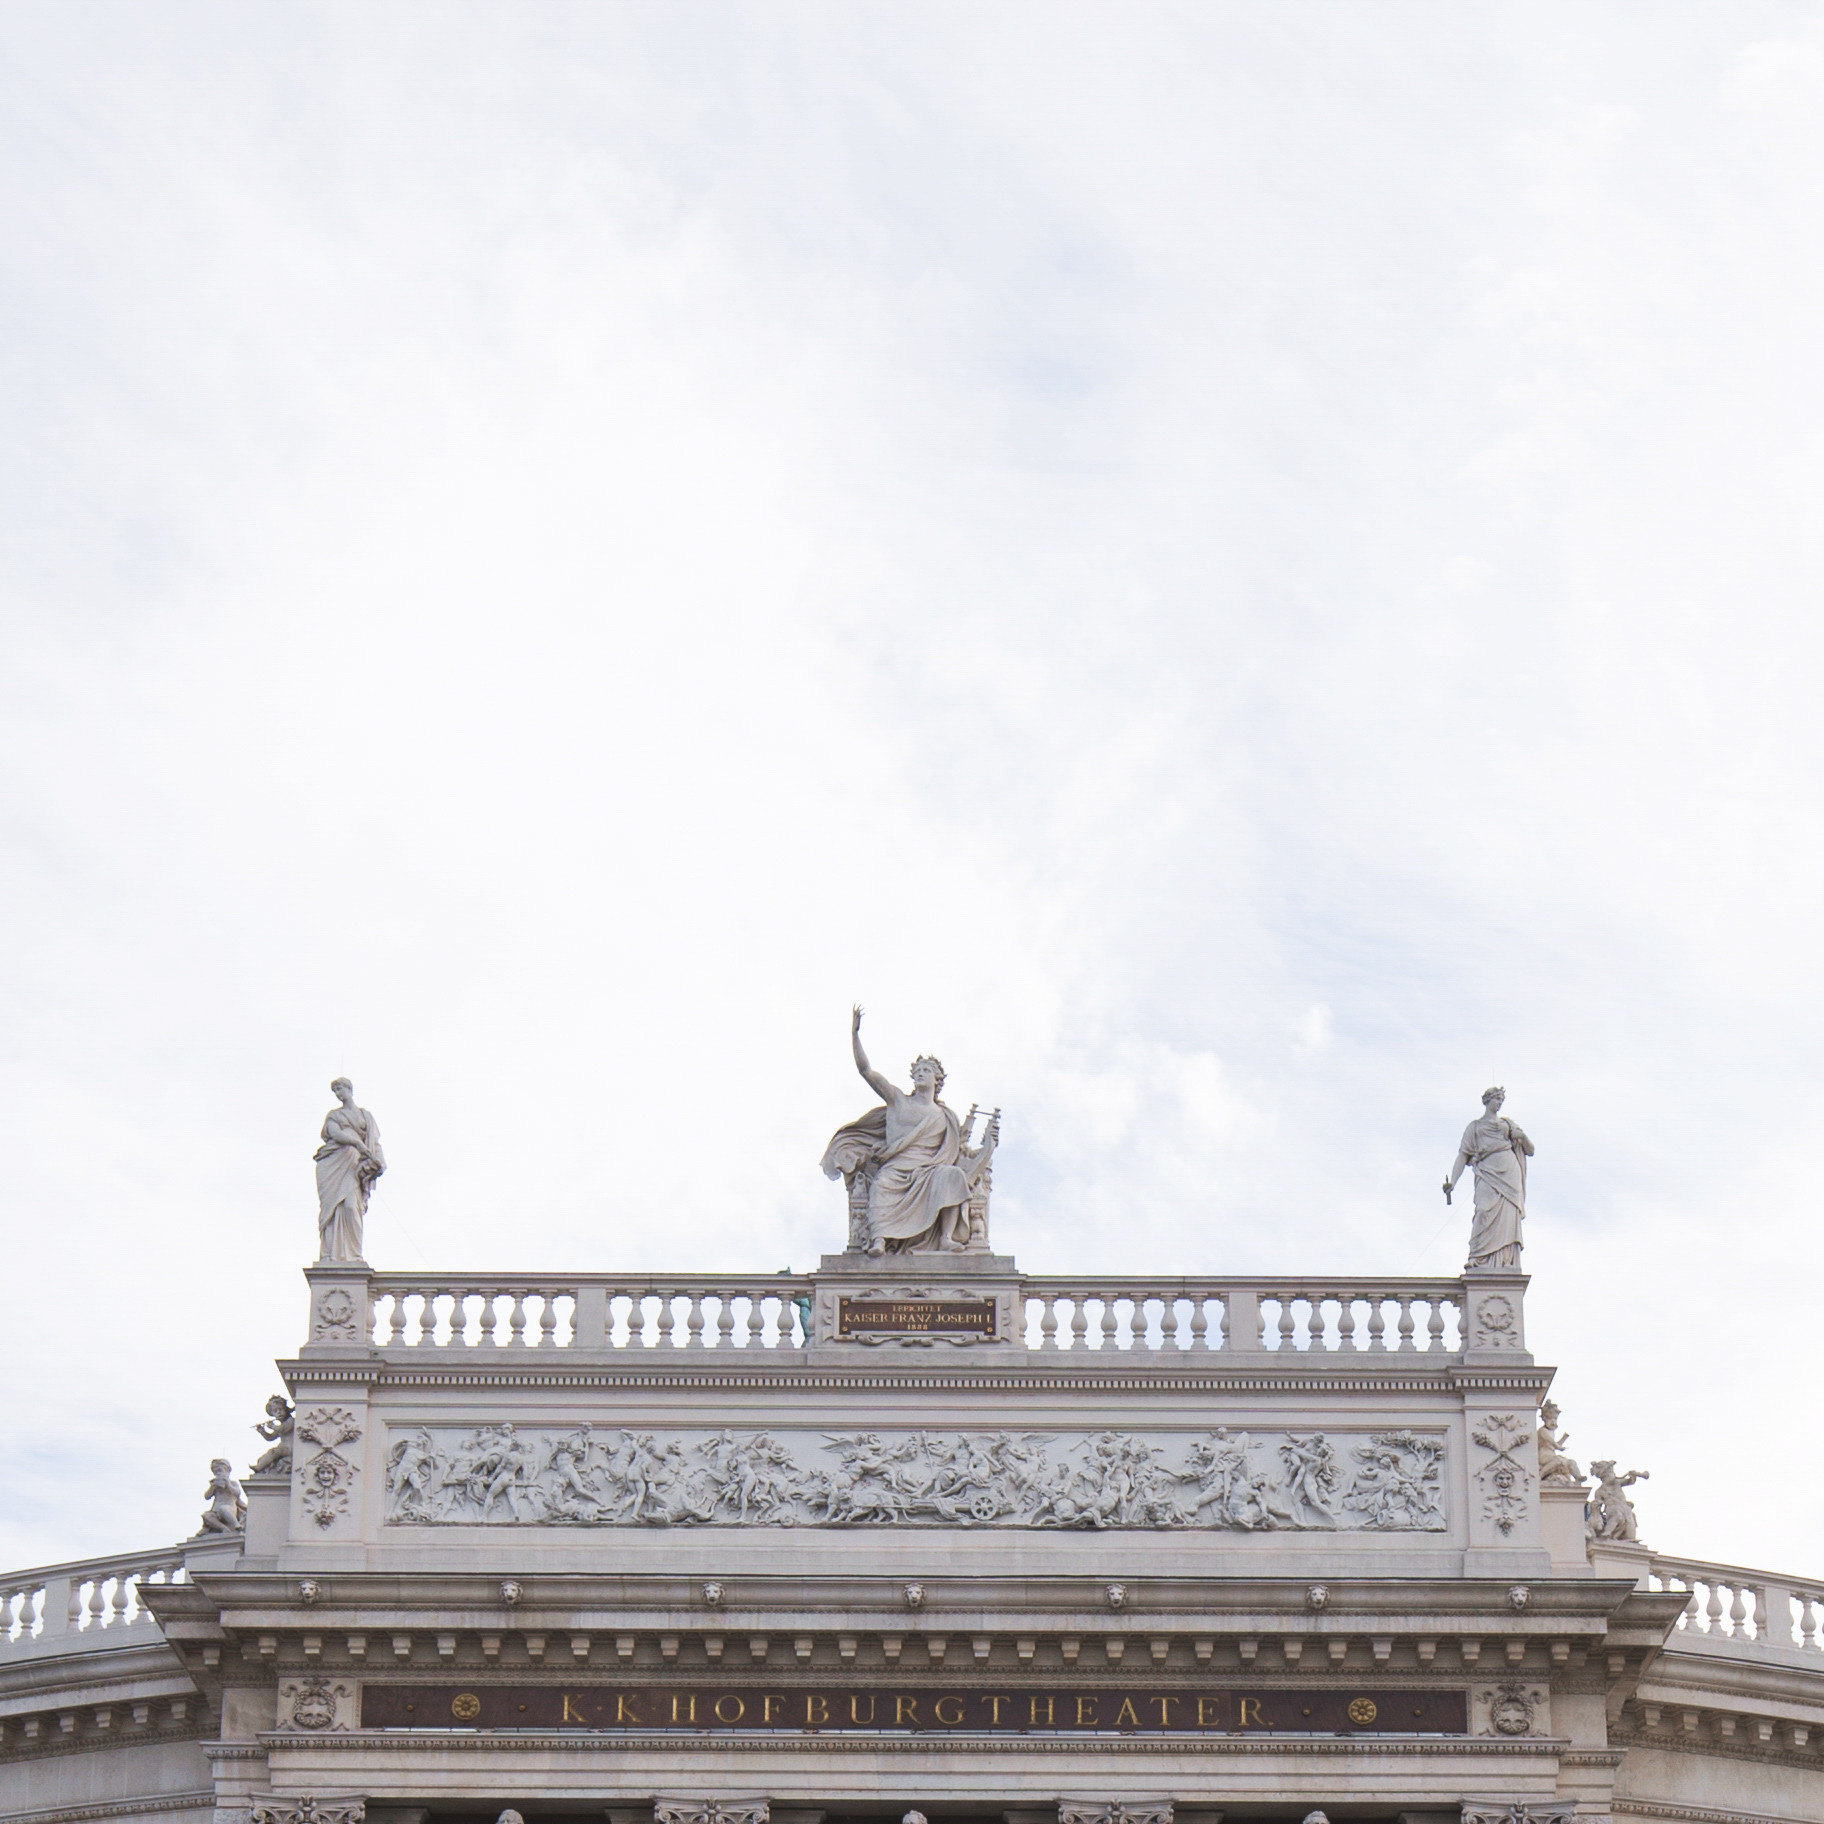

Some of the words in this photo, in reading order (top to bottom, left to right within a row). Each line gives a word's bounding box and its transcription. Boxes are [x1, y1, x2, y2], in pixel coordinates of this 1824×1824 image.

[844, 1313, 889, 1323] KAISER
[892, 1313, 932, 1323] FRANZ
[935, 1314, 982, 1323] JOSEPH
